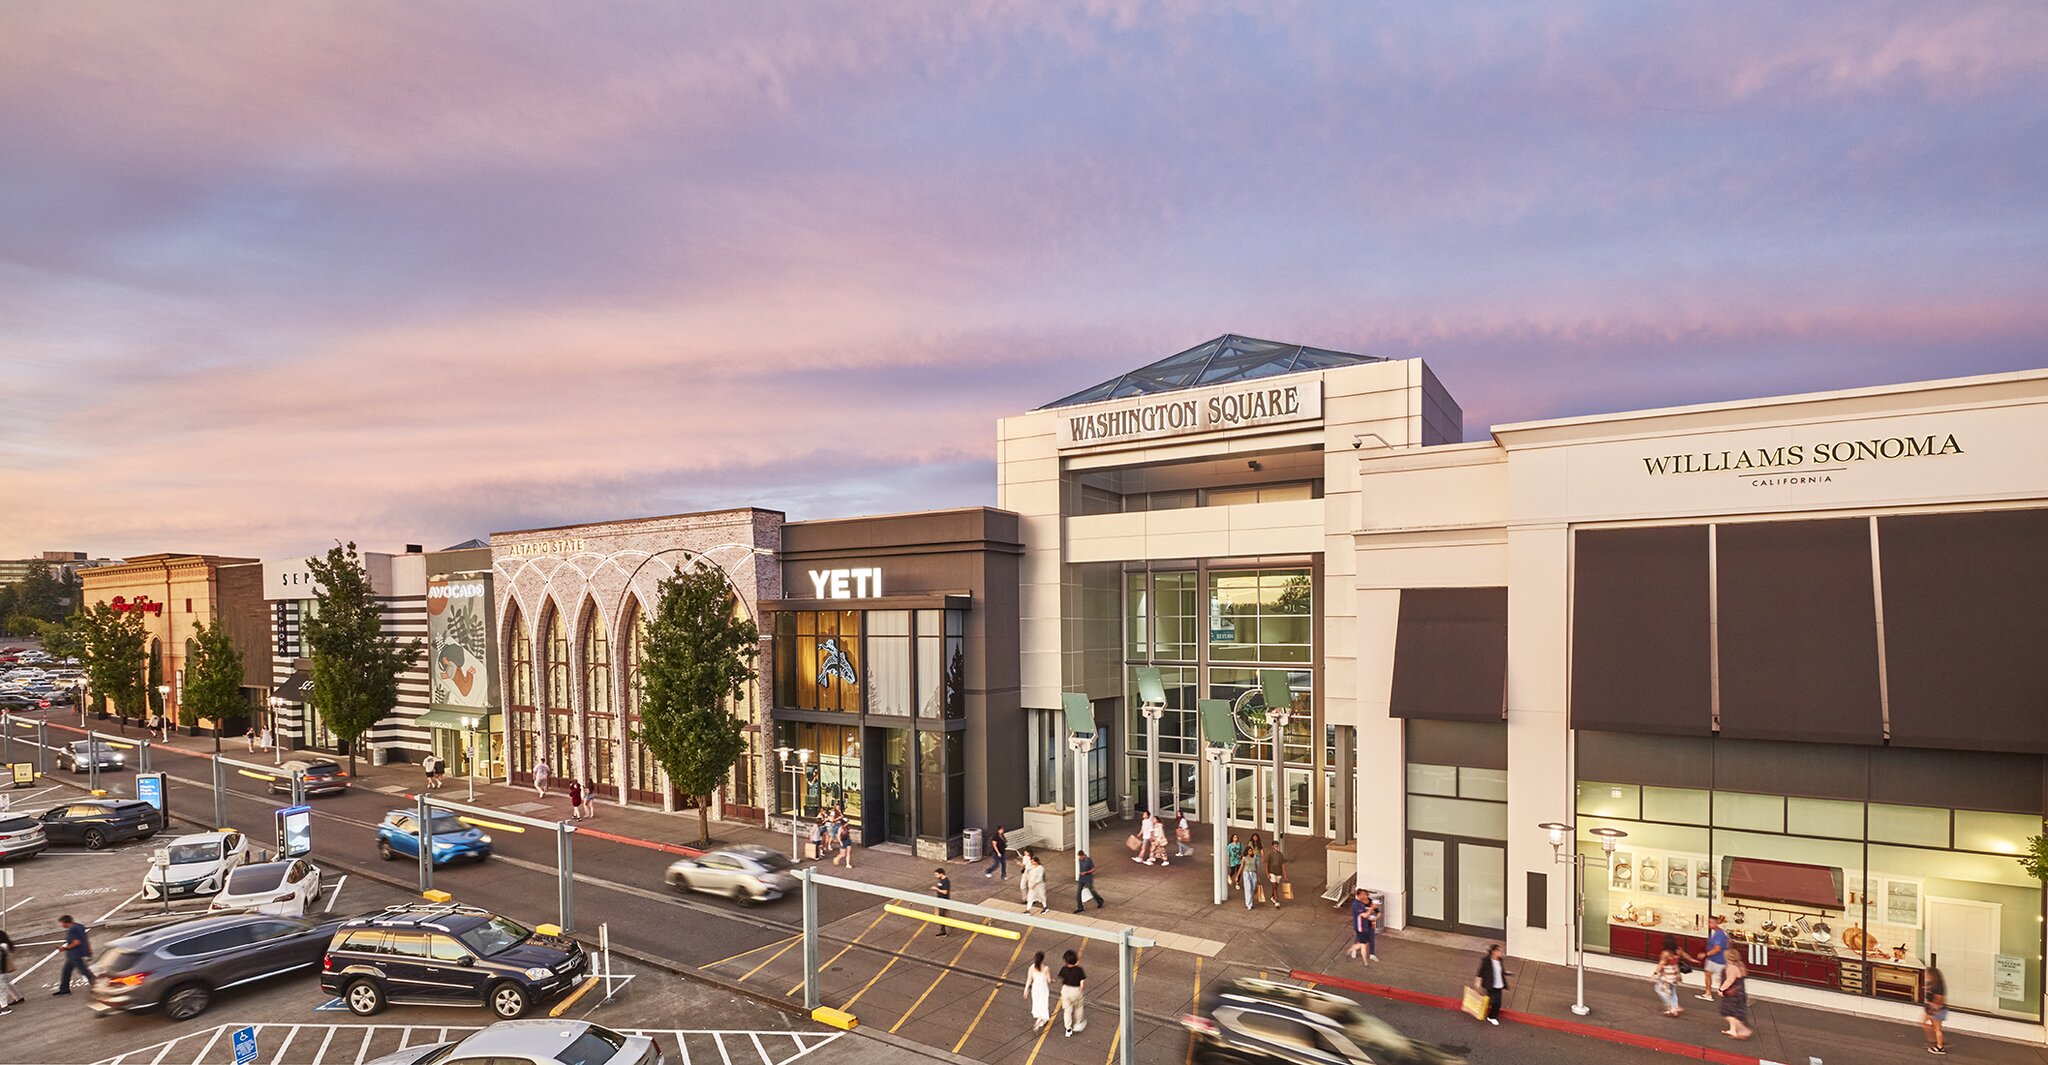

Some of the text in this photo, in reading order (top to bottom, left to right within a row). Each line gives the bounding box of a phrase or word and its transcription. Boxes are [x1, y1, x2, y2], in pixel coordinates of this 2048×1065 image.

[1069, 386, 1299, 442] WASHINGTON SQUARE
[1643, 433, 1964, 476] WILLIAMS SONOMA
[1752, 475, 1832, 487] CALIFORNIA
[552, 540, 583, 552] STATE
[428, 584, 485, 599] AVOCADO
[808, 567, 882, 600] YETI
